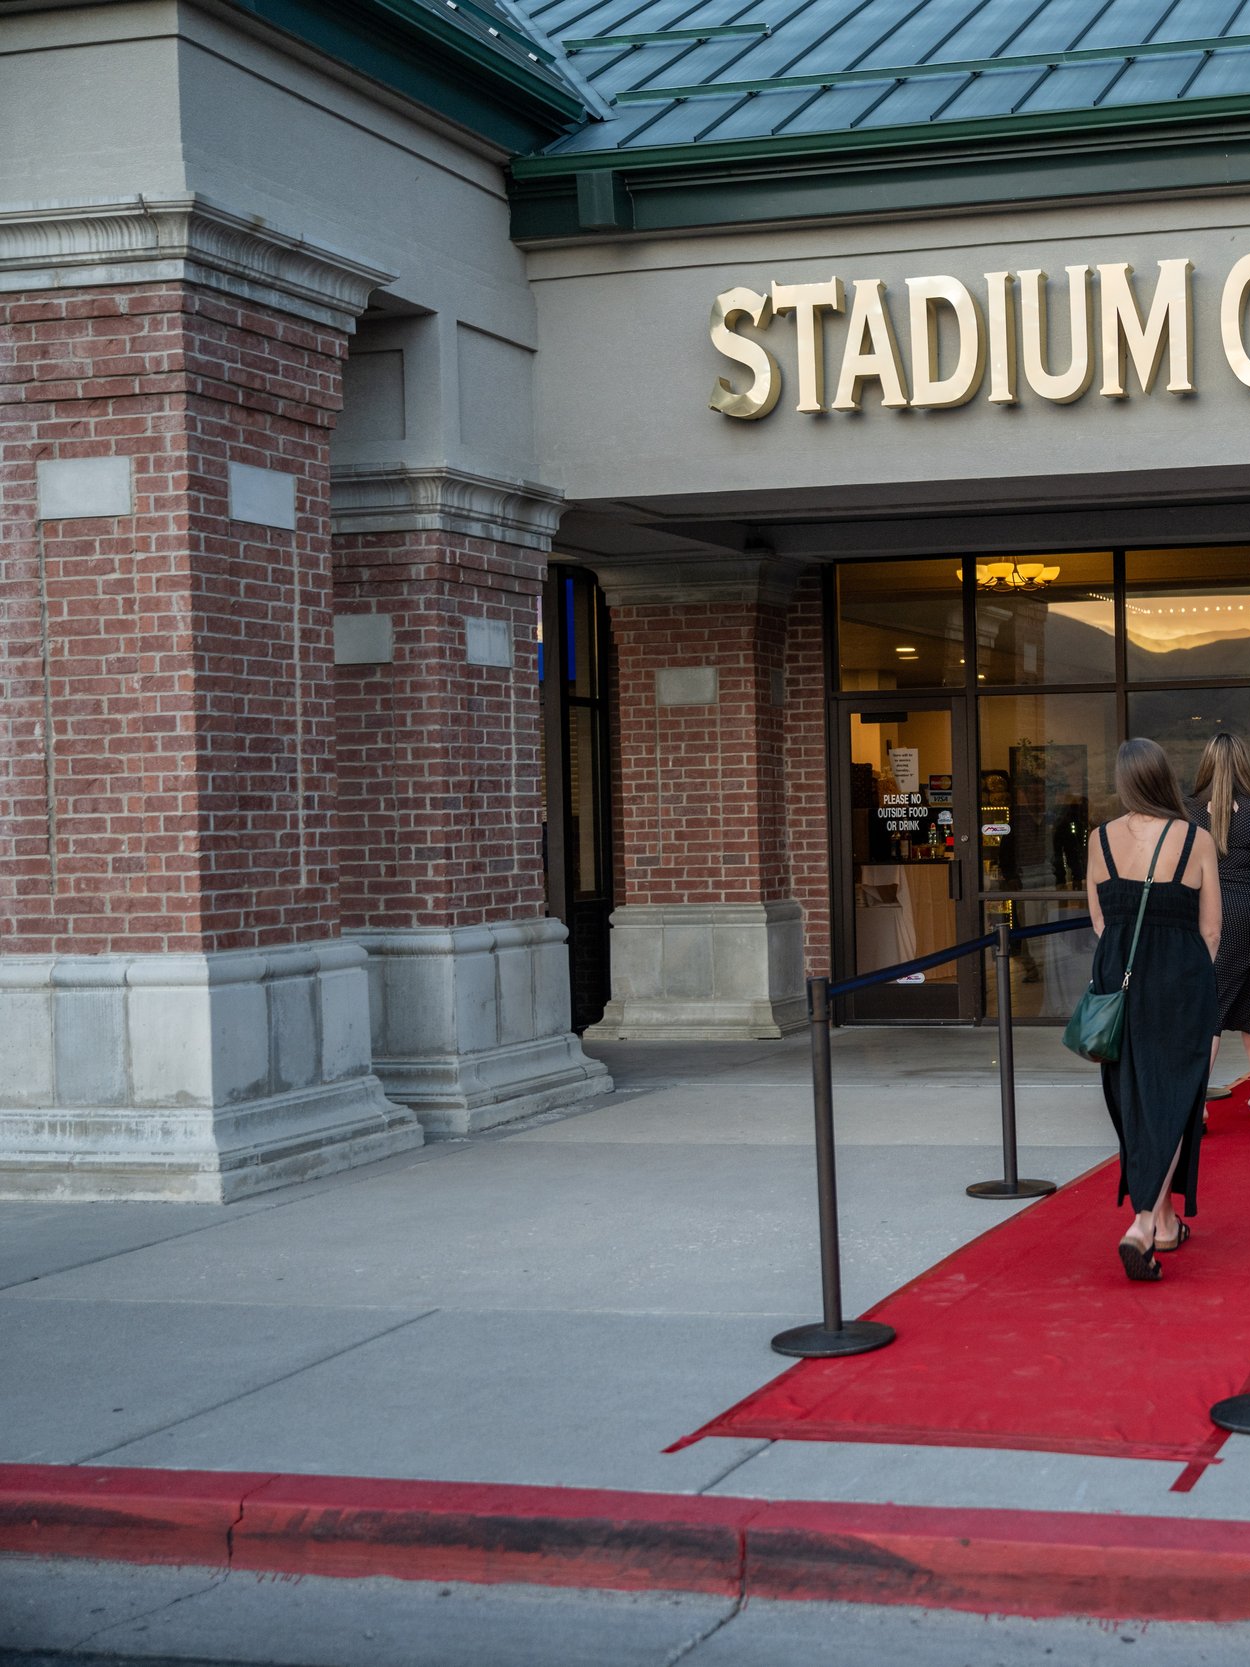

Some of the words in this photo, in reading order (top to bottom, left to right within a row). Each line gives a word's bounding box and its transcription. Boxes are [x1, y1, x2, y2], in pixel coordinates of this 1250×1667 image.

[708, 258, 1196, 421] STADIUM
[883, 794, 909, 805] PLEASE
[911, 793, 922, 804] NO
[877, 807, 907, 818] OUTSIDE
[908, 806, 929, 818] FOOD
[886, 820, 897, 832] OR
[898, 820, 920, 831] DRINK
